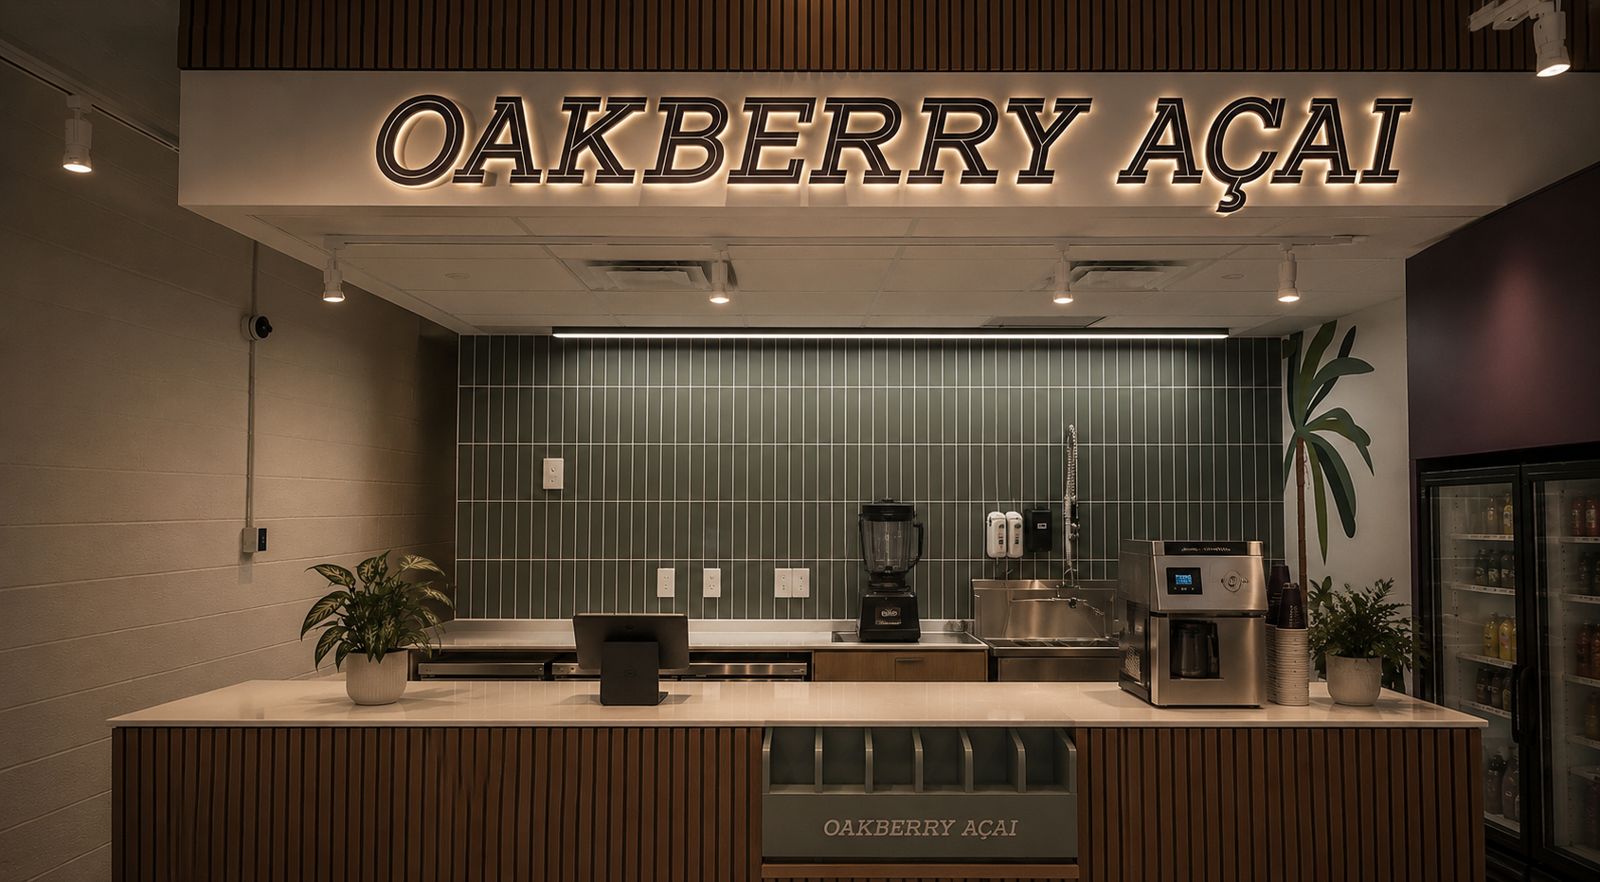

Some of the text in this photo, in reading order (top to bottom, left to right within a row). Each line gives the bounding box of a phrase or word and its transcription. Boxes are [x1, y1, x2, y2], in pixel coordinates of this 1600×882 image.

[375, 94, 1413, 213] OAKBERRY AÇAI
[823, 819, 1018, 840] OAKBERRY AÇAI
